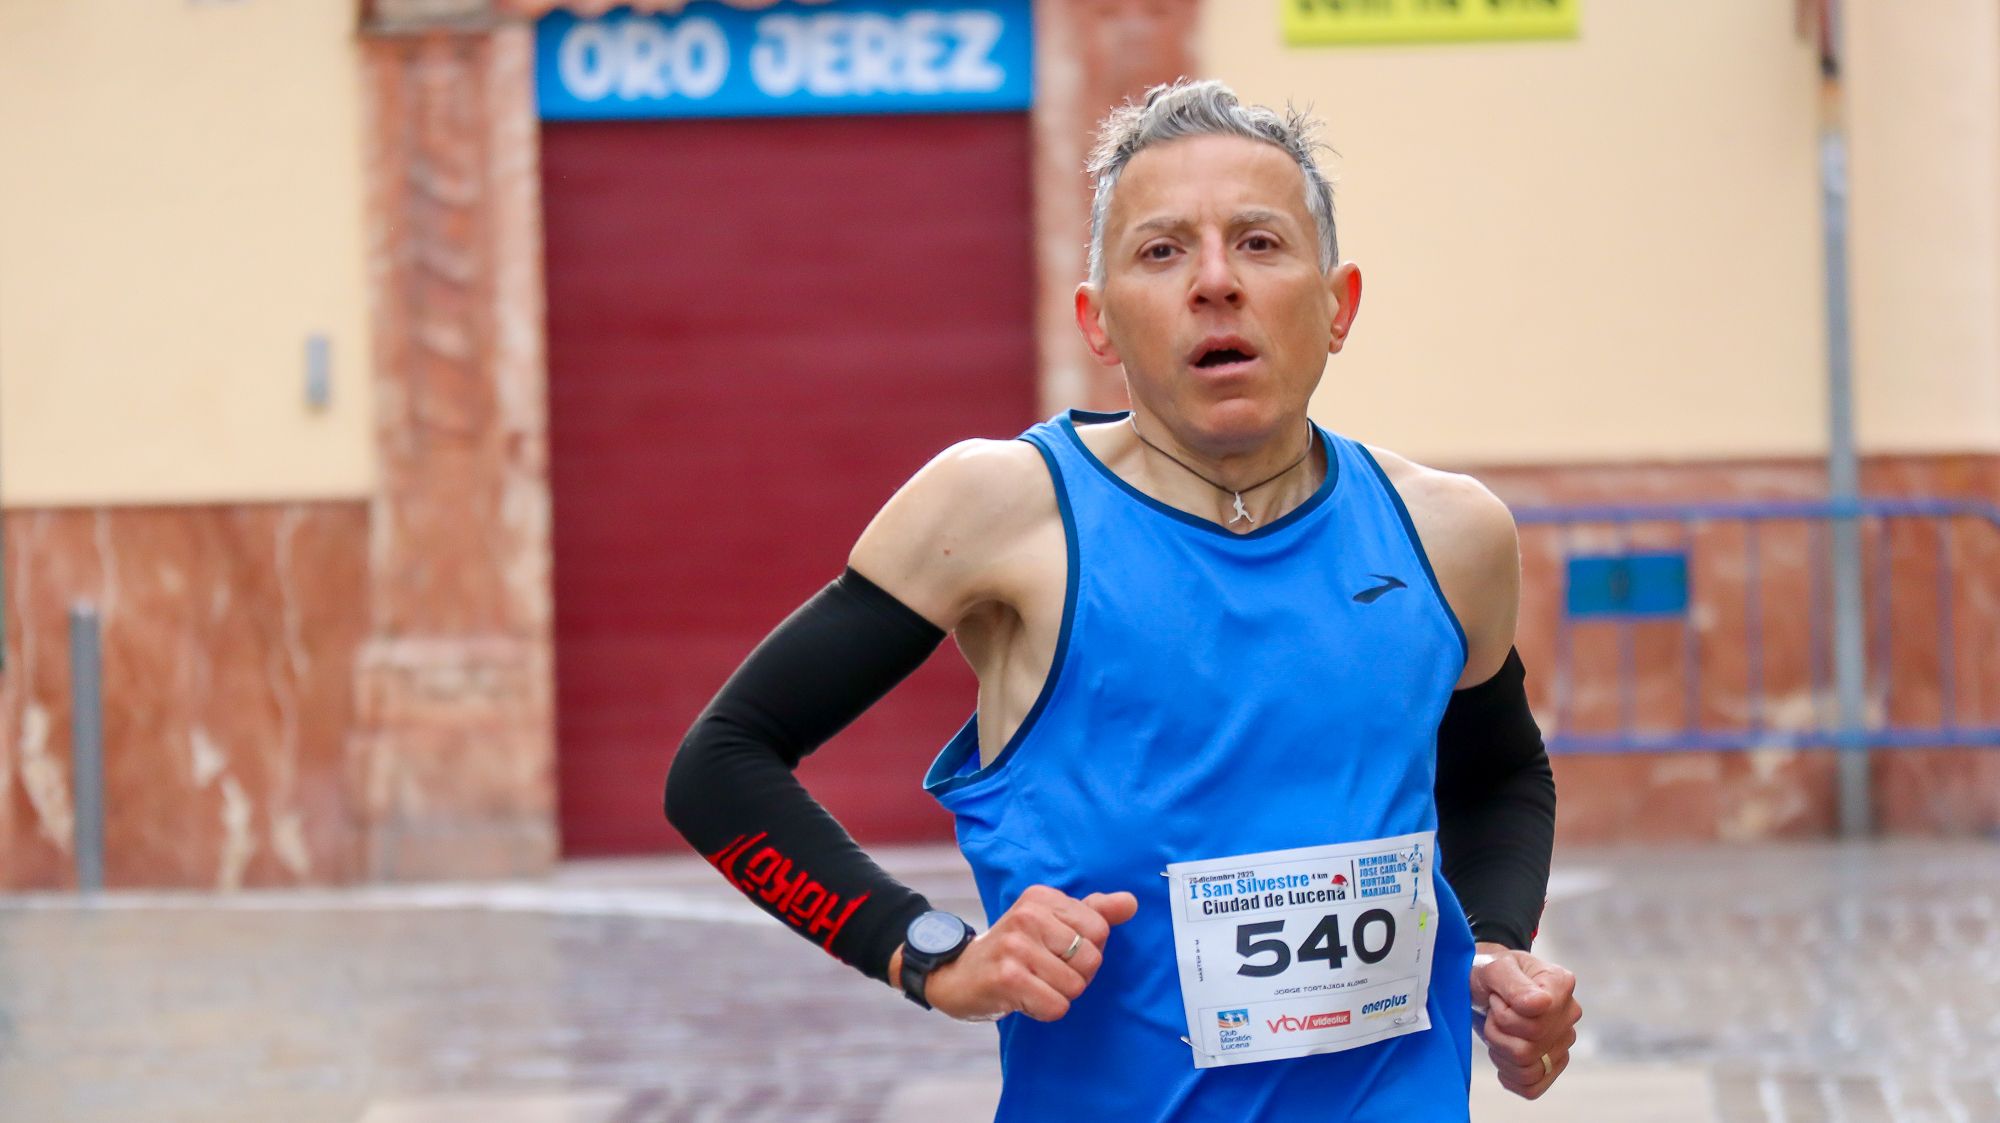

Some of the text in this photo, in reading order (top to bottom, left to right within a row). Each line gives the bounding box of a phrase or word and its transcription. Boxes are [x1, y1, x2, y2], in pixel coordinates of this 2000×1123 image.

[558, 10, 1005, 101] ORO JEREZ
[1359, 854, 1398, 867] MEMORIAL
[1380, 862, 1407, 875] CARLOS
[1190, 884, 1198, 899] I
[1202, 882, 1233, 898] San
[1237, 874, 1309, 894] Silvestre
[1361, 875, 1396, 888] HURTADO
[1203, 889, 1345, 915] Ciudad de Lucena
[1236, 908, 1396, 977] 540
[1274, 987, 1301, 995] JORGE
[1361, 994, 1408, 1014] enerplus
[1219, 1029, 1238, 1037] Club
[1221, 1042, 1250, 1051] Lucena
